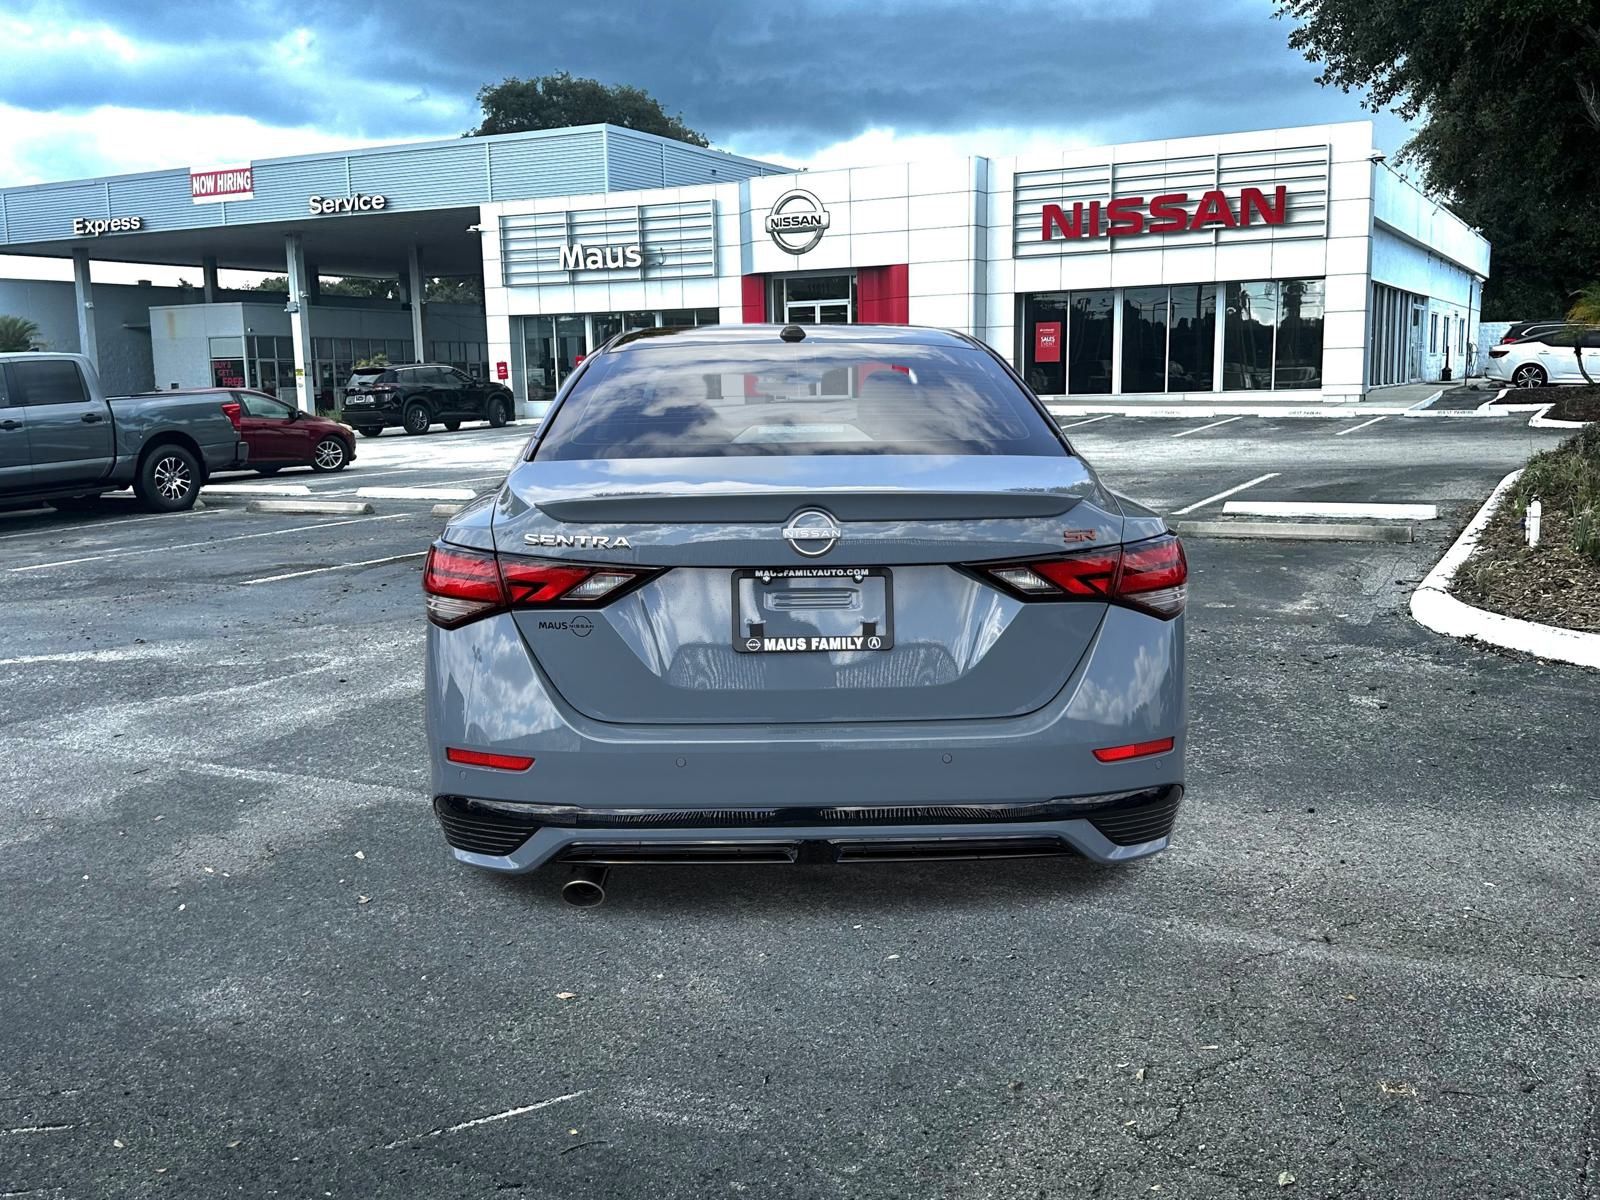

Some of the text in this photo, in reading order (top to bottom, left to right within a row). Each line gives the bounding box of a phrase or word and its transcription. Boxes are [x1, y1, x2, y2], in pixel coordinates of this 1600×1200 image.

[192, 170, 251, 195] NOW HIRING
[308, 193, 386, 215] Service
[1042, 185, 1287, 240] NISSAN
[73, 216, 141, 237] Express
[770, 215, 823, 229] NISSAN
[559, 244, 643, 270] Maus
[523, 533, 632, 550] SENTRA
[783, 528, 841, 539] NISSAN
[1063, 528, 1097, 543] SR
[538, 621, 568, 630] MAUS
[764, 636, 864, 651] MAUS FAMILY
